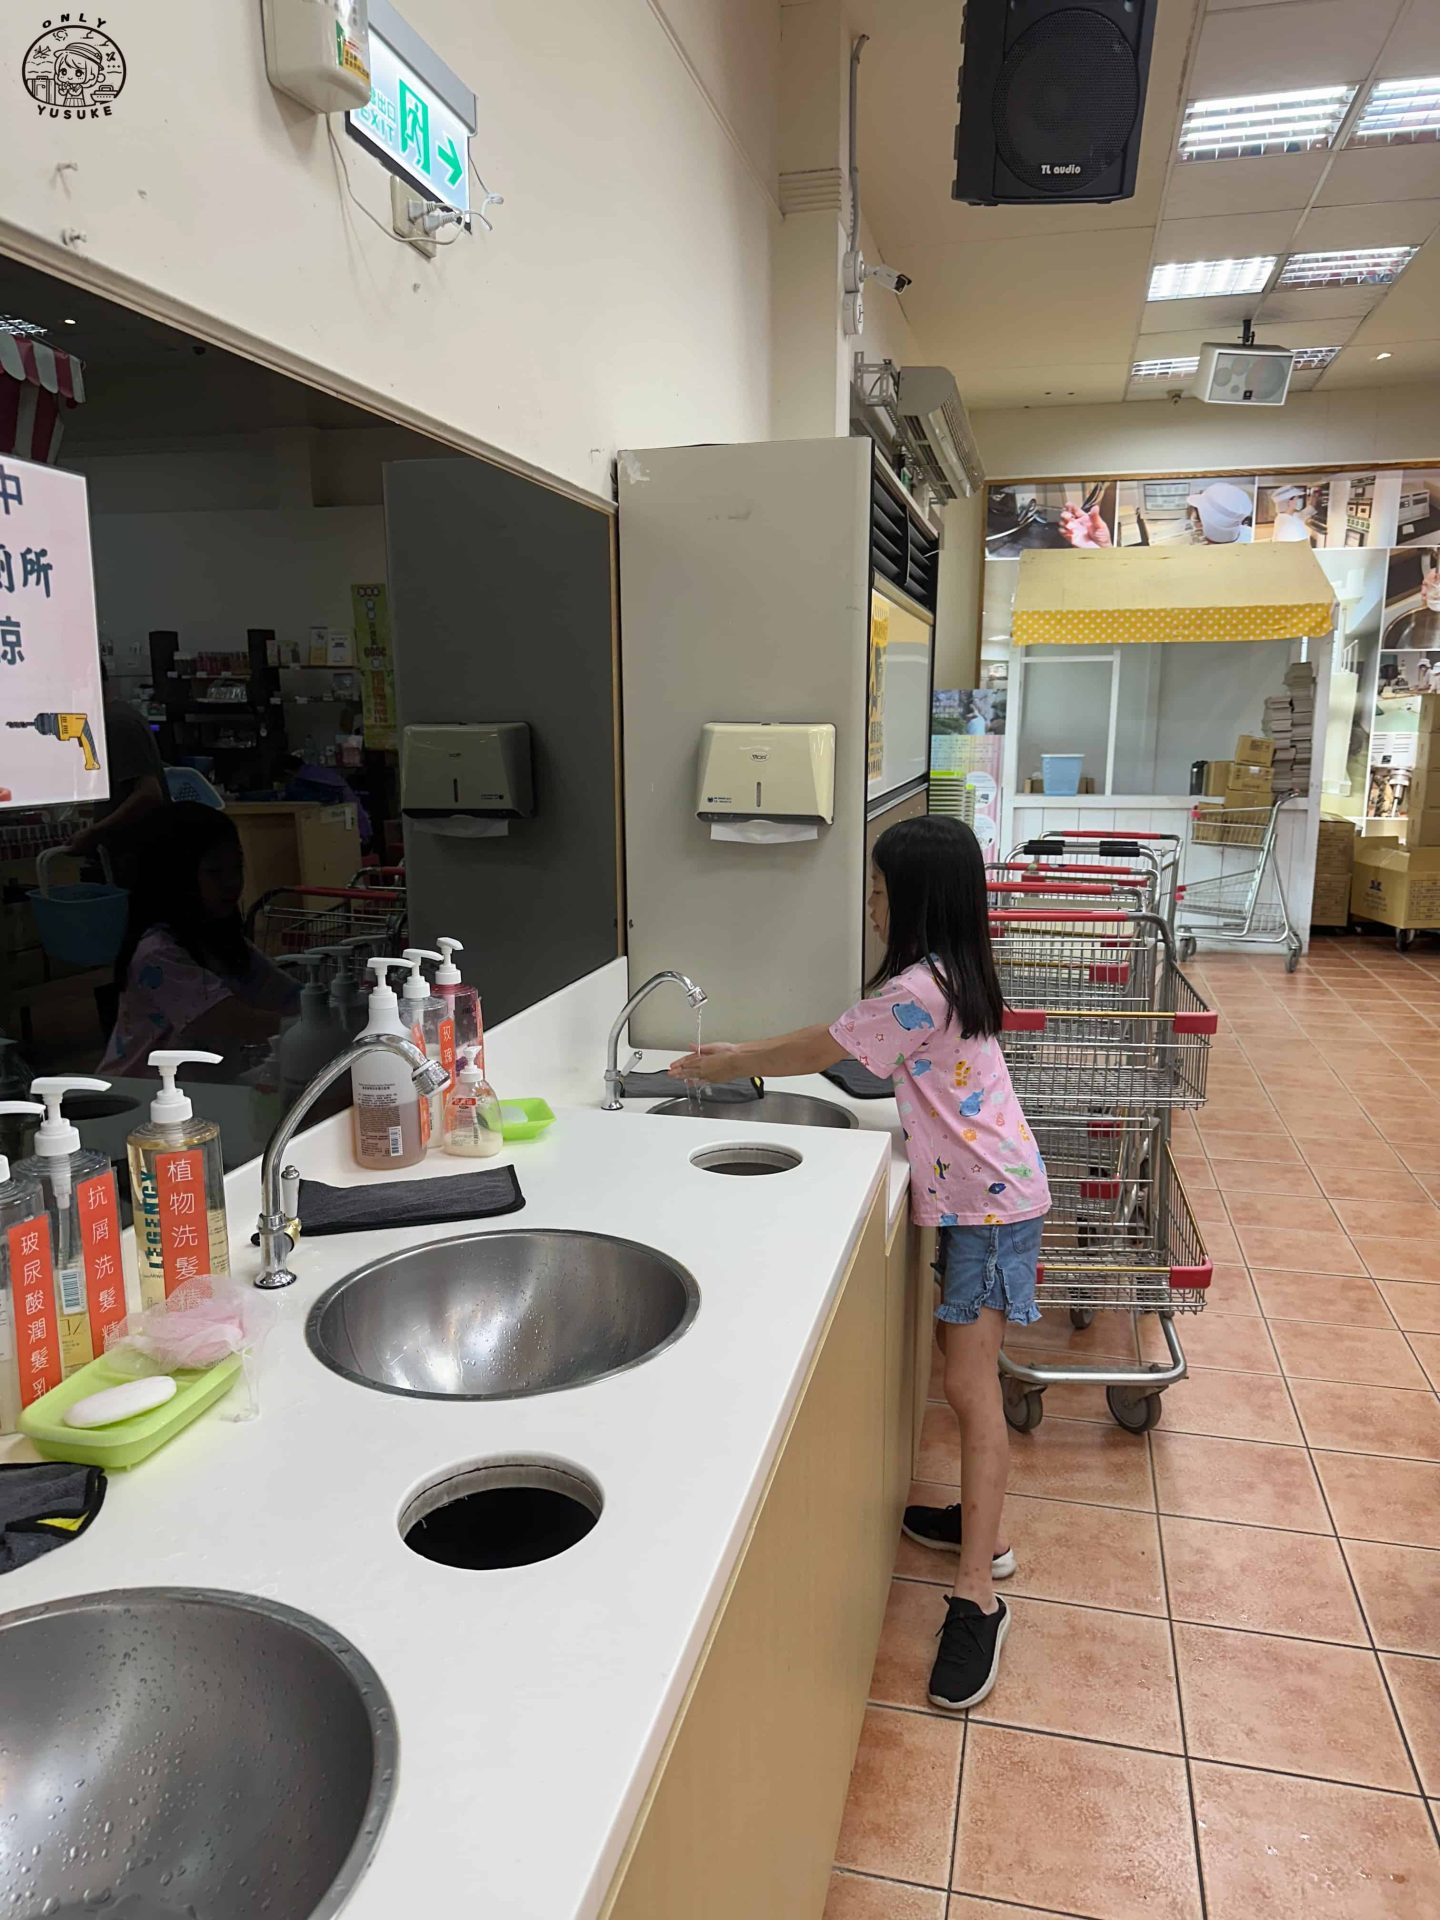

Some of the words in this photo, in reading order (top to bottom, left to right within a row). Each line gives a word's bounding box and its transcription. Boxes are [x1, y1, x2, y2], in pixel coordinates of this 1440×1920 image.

[360, 106, 394, 141] EXIT
[1041, 164, 1051, 174] TL
[1053, 164, 1081, 174] audio
